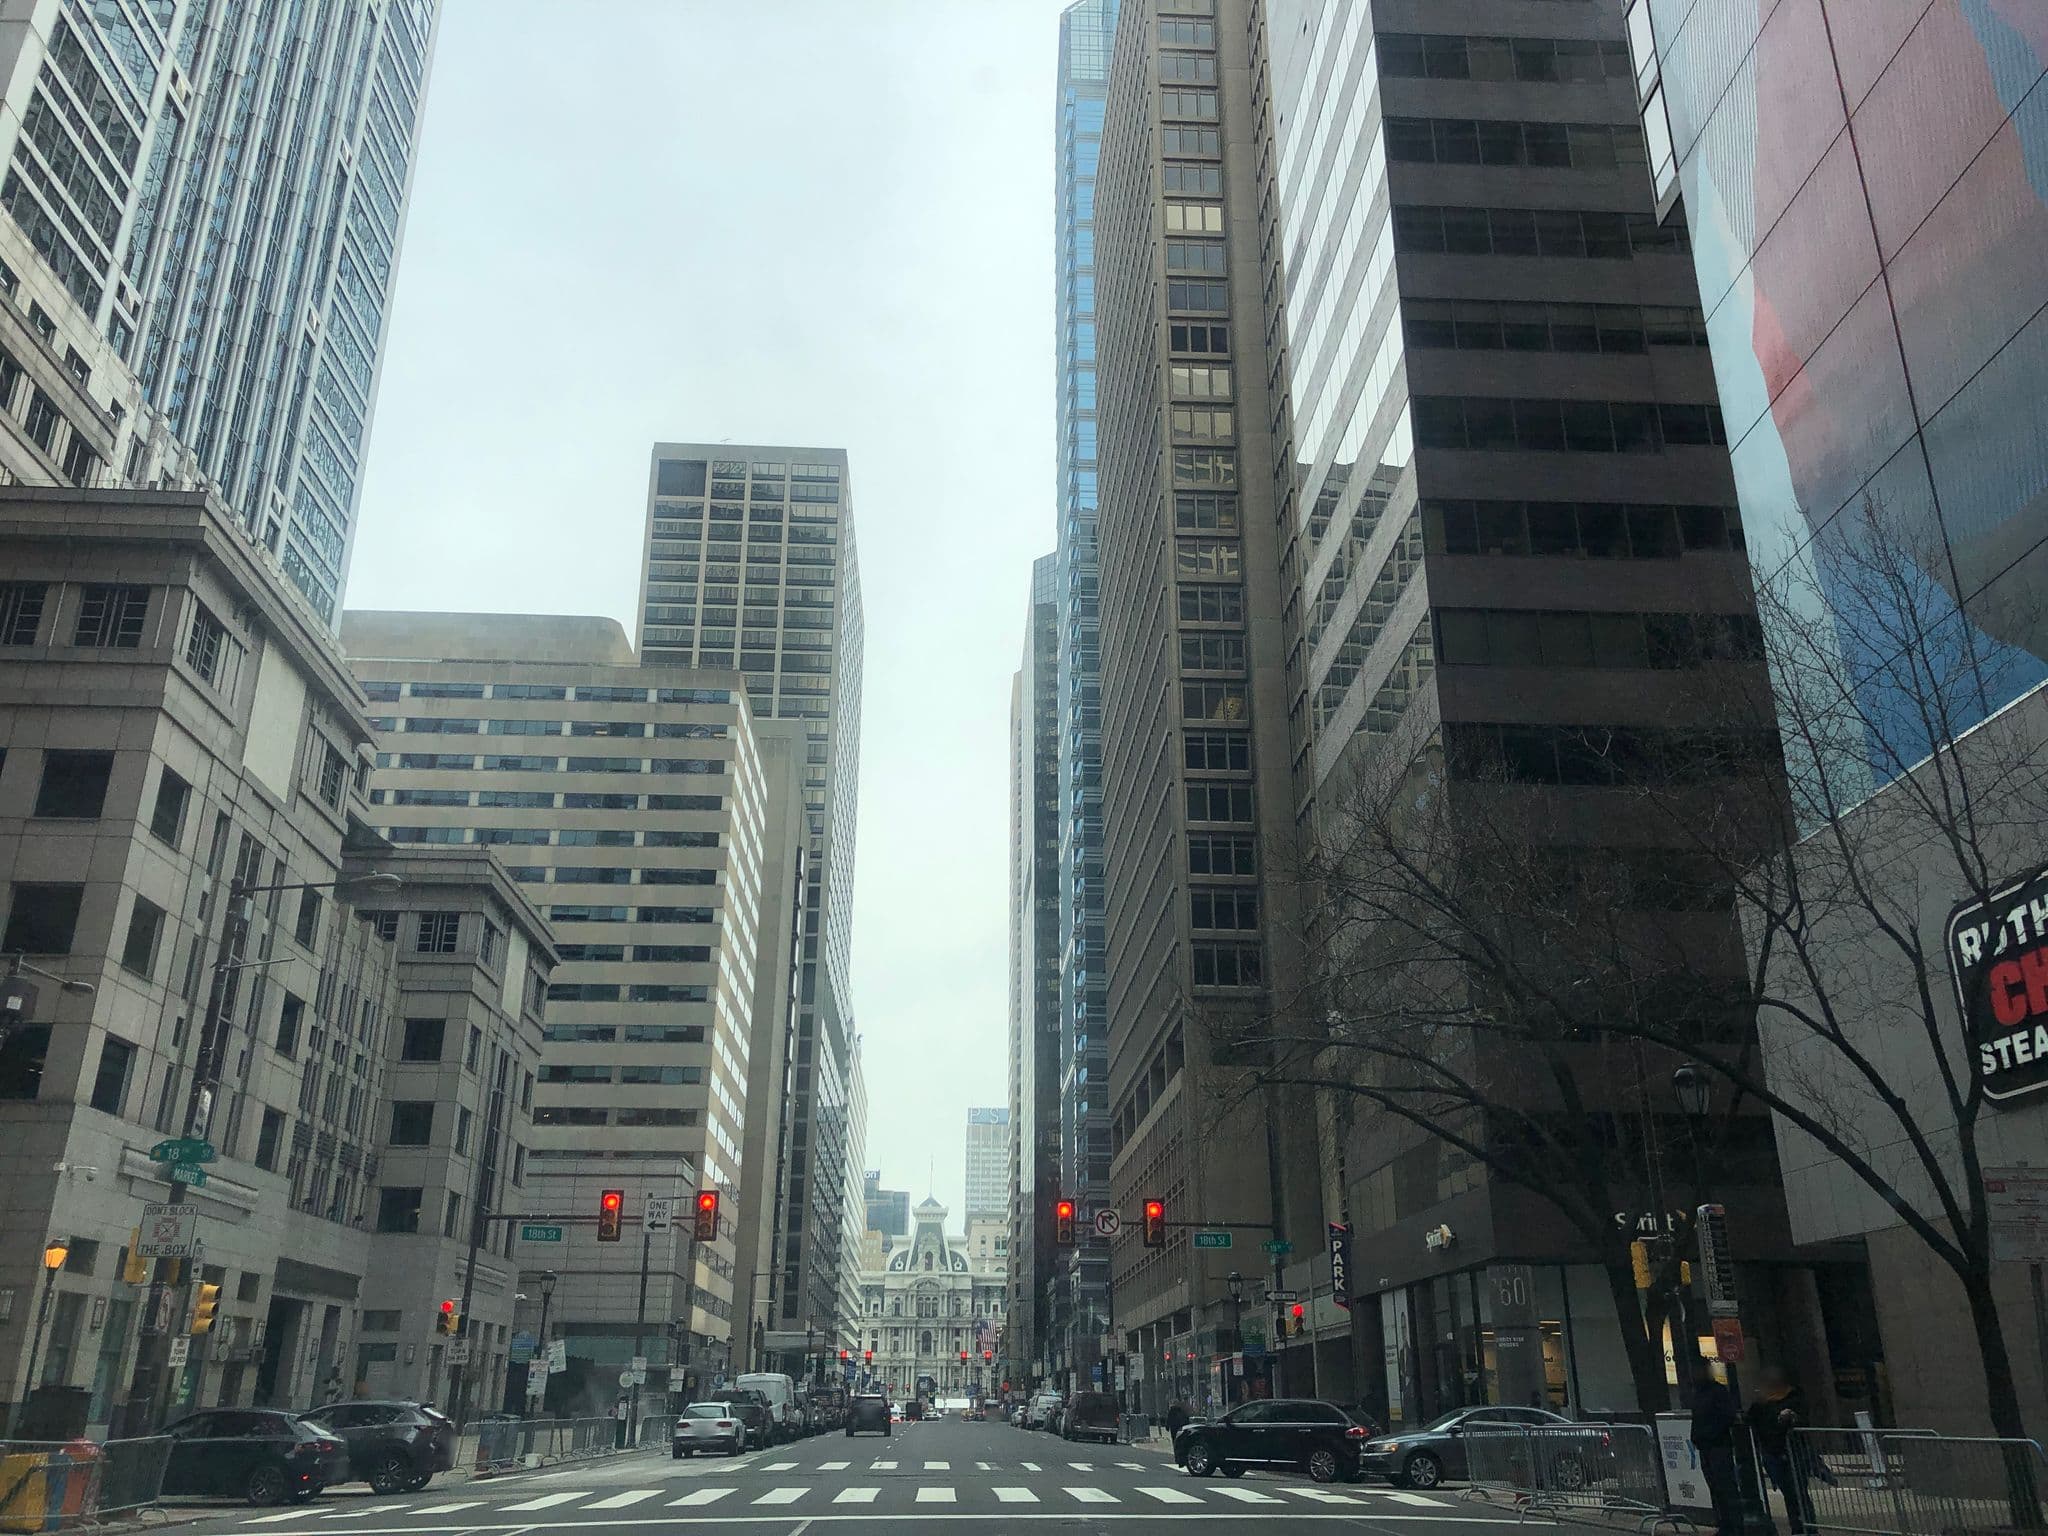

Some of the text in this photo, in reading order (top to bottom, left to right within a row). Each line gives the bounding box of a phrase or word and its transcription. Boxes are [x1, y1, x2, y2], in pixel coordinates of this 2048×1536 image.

[173, 1167, 198, 1185] MARKET
[169, 1205, 196, 1216] BLOCK
[649, 1200, 668, 1210] ONE
[647, 1210, 668, 1219] WAY
[528, 1228, 557, 1240] 18th St
[1199, 1235, 1226, 1246] 18th St
[140, 1244, 160, 1255] THE
[164, 1244, 187, 1255] BOX
[1332, 1239, 1345, 1291] PARK
[707, 1336, 715, 1347] P
